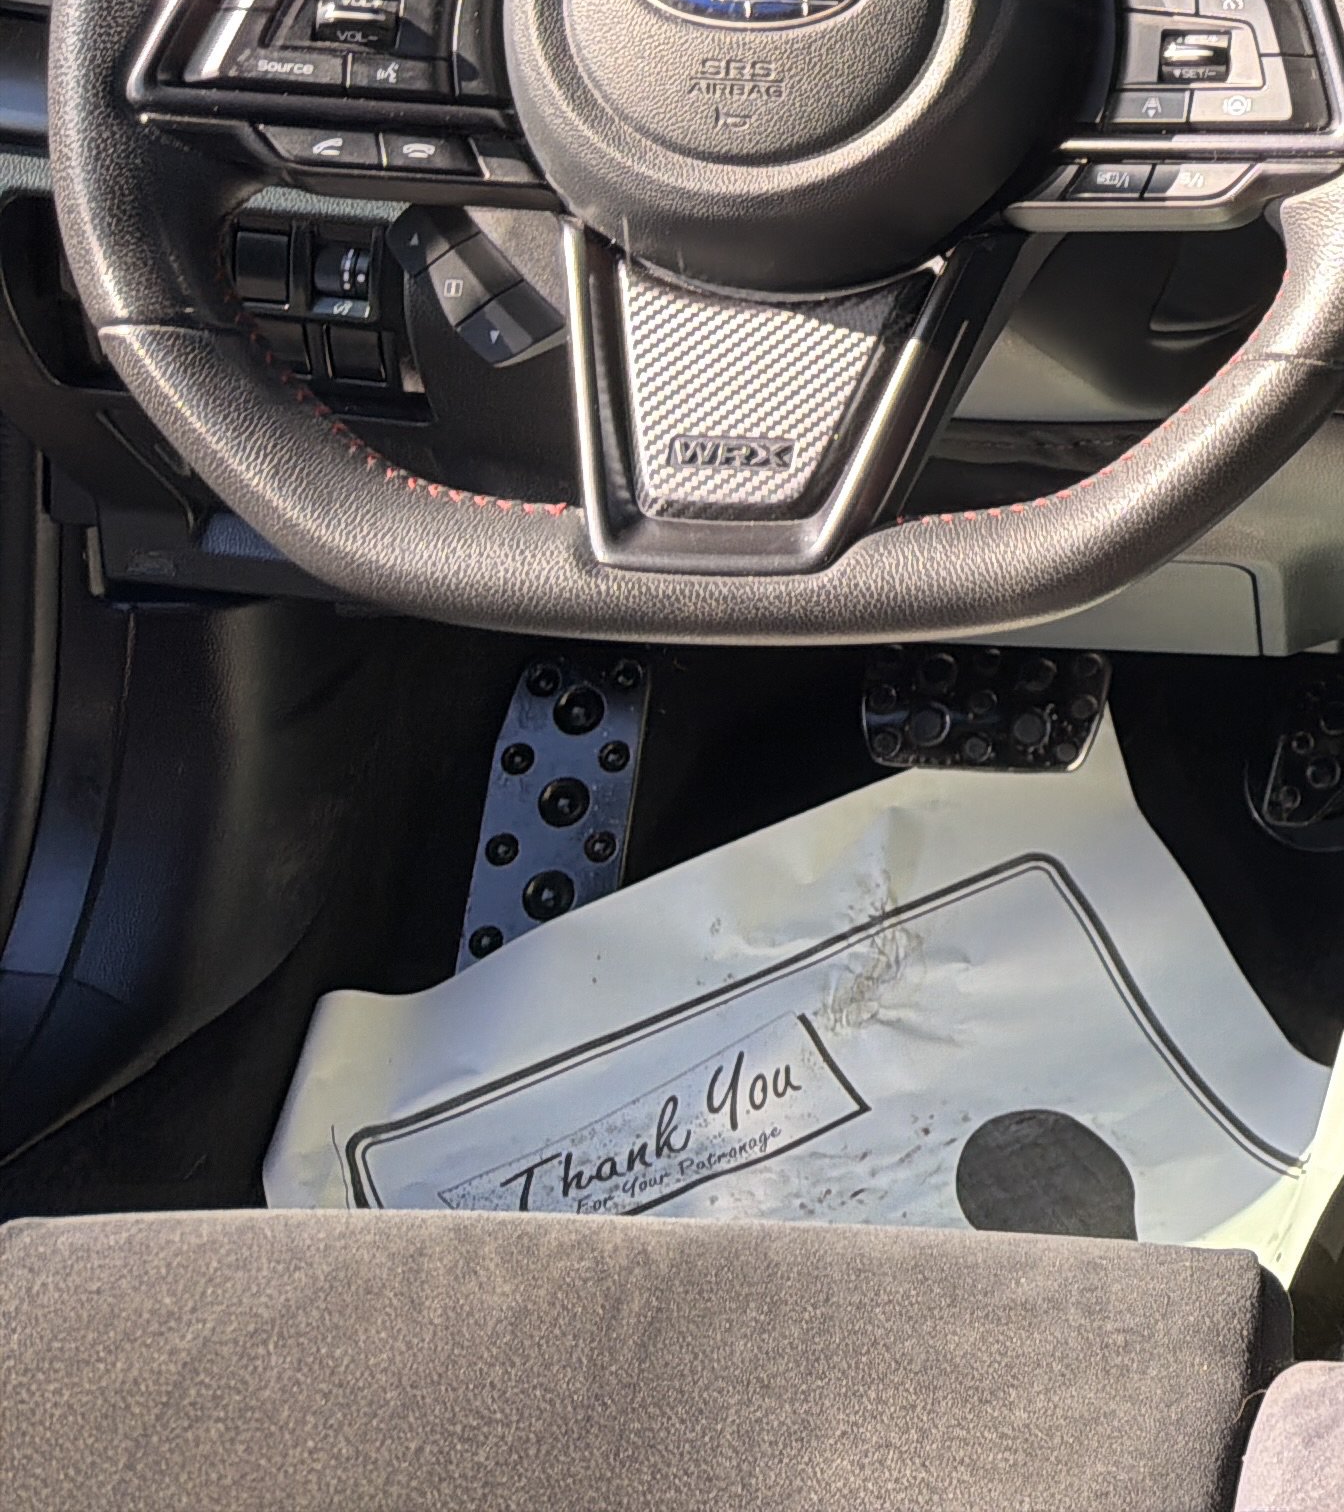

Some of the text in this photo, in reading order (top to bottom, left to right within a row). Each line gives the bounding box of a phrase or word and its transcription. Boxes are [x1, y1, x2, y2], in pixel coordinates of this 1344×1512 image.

[257, 59, 314, 75] Source
[700, 58, 773, 78] SRS
[687, 82, 784, 98] AIRBAG
[672, 438, 796, 469] WRX
[500, 1050, 802, 1212] Thank You
[577, 1126, 783, 1215] For Your Patronage
